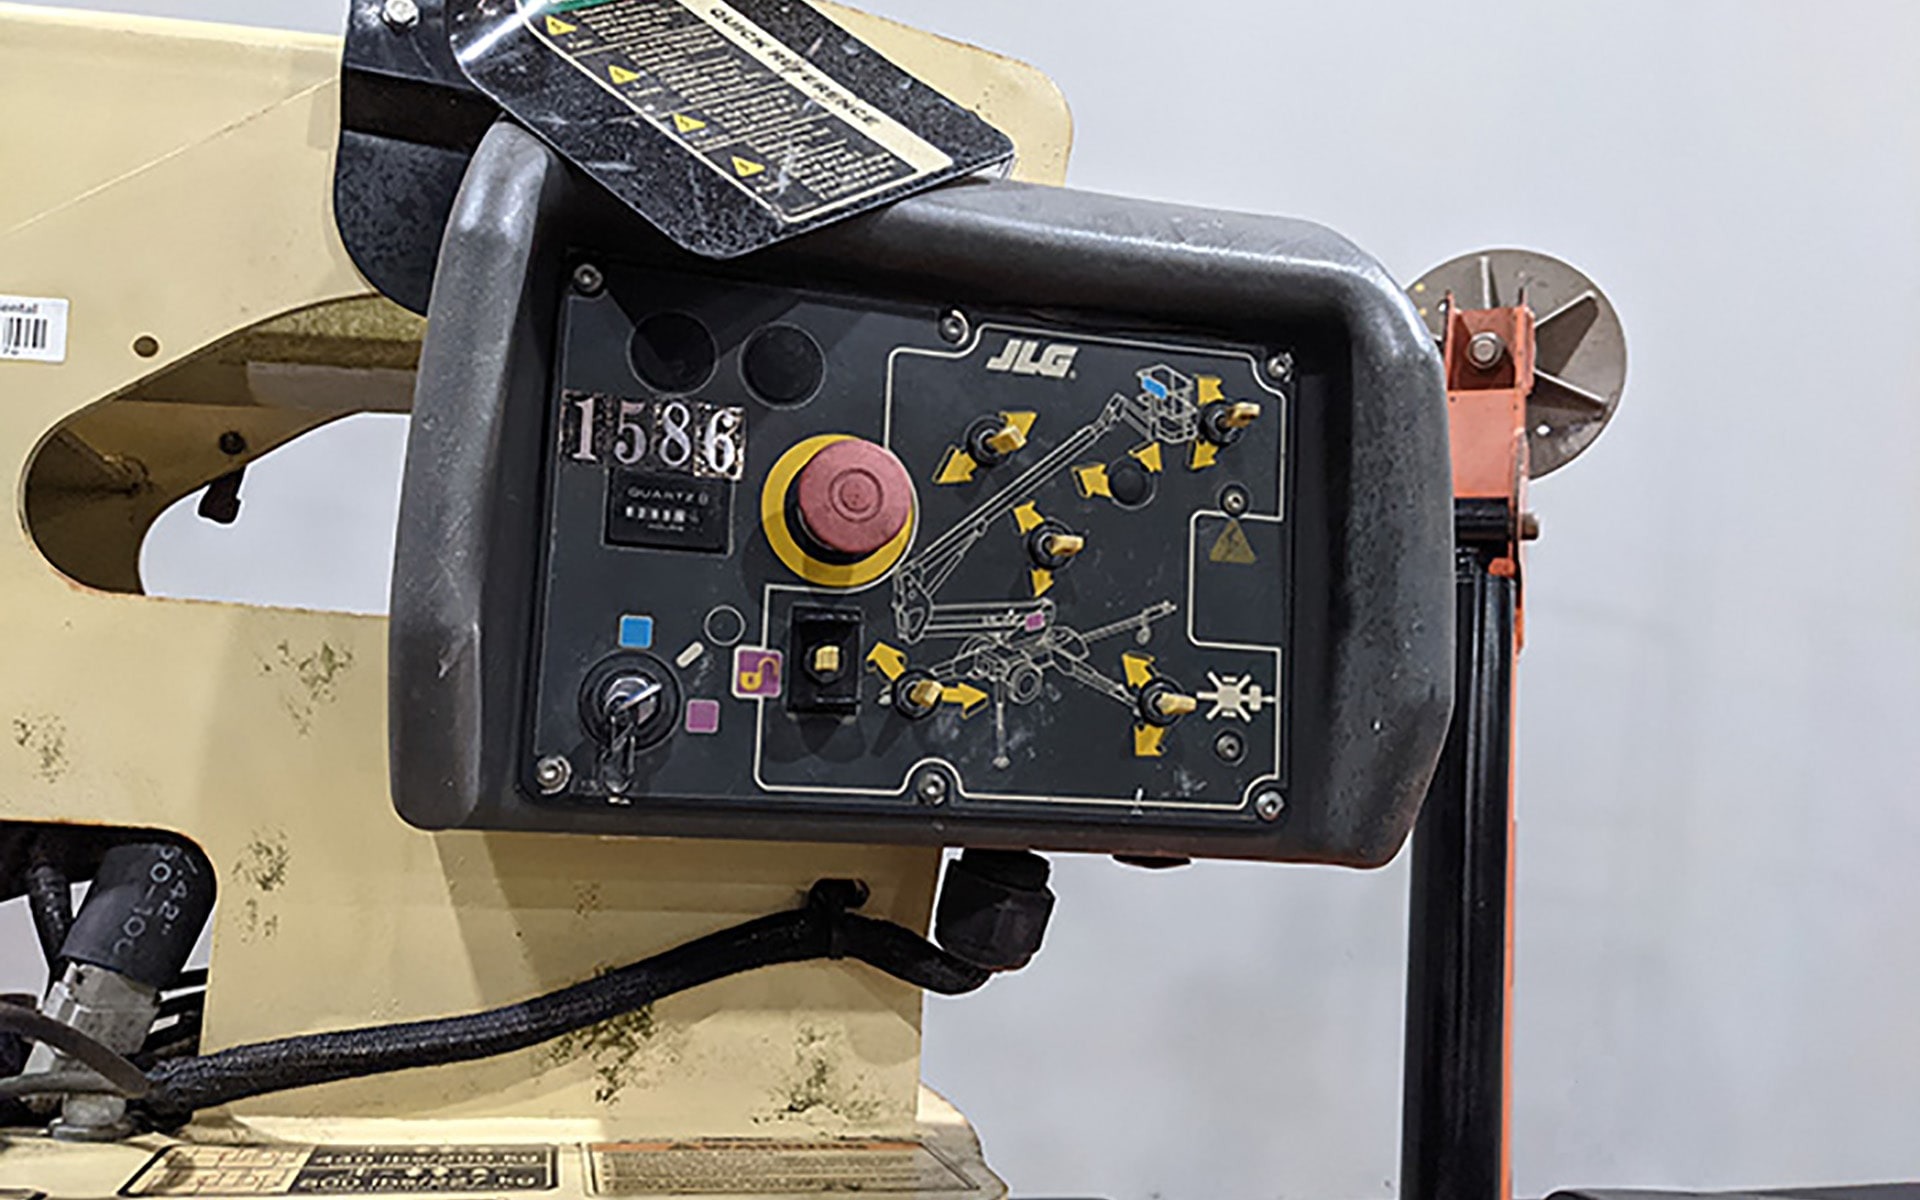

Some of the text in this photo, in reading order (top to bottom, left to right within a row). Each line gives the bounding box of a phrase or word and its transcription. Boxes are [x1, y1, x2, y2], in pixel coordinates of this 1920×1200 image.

[709, 7, 770, 49] QUICK
[767, 50, 881, 127] REFERENCE
[985, 339, 1078, 378] JLG
[572, 396, 739, 473] 1586
